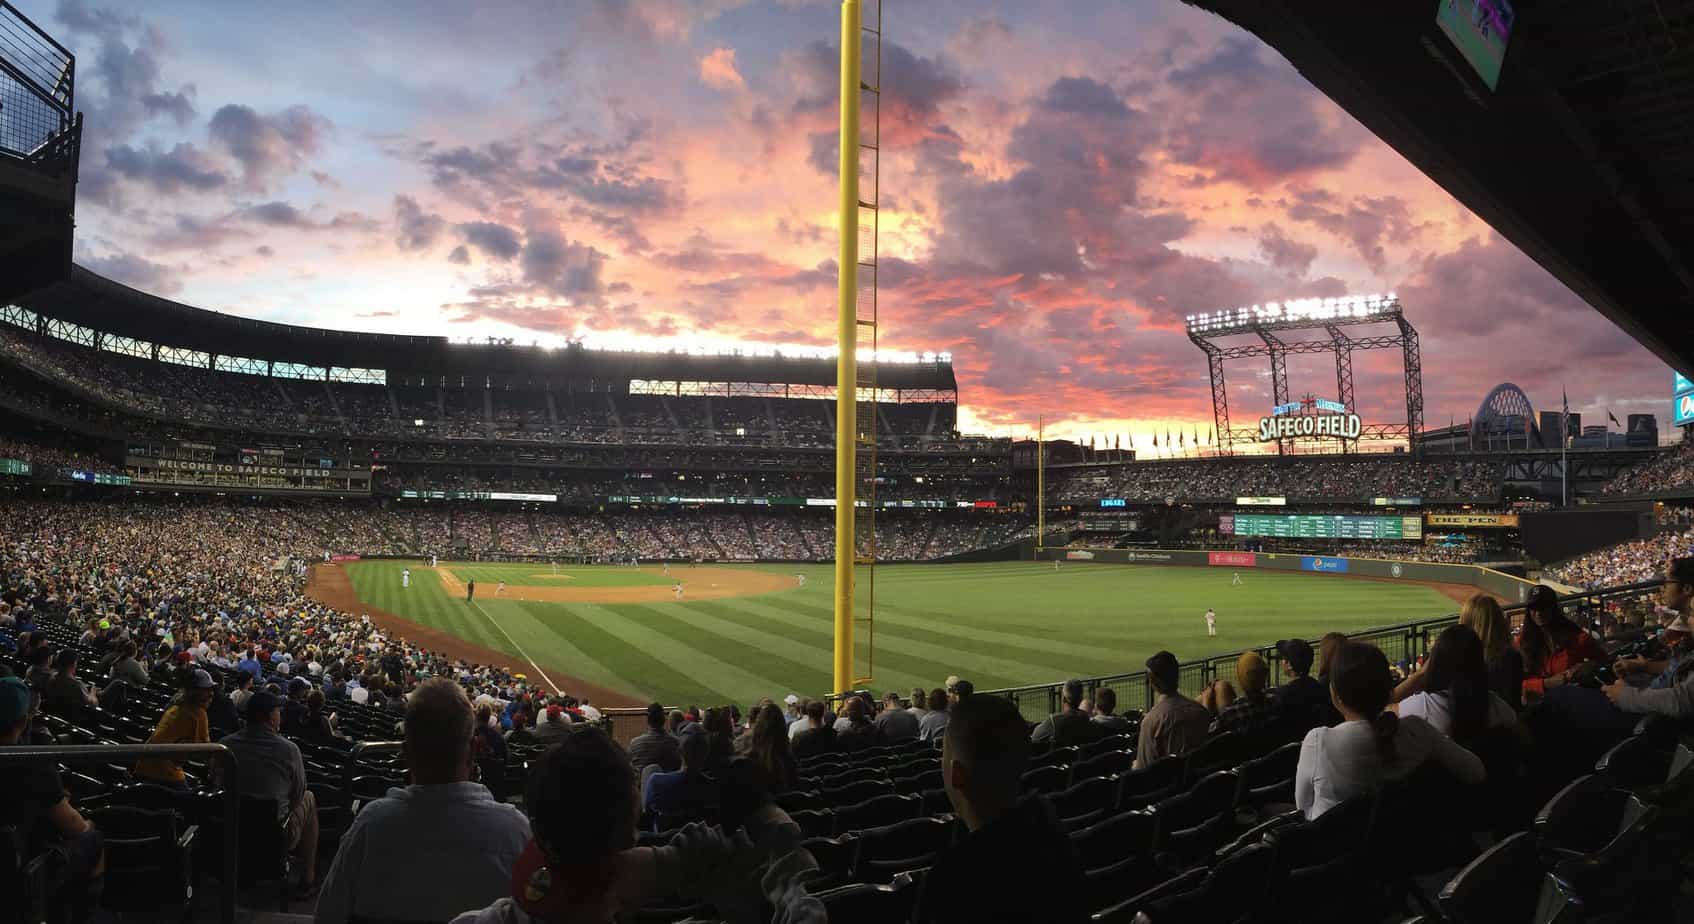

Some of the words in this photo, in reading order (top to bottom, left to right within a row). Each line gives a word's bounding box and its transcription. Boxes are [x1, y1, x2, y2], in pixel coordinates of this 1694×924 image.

[1260, 417, 1314, 440] SAFECO
[1317, 415, 1360, 438] FIELD
[158, 459, 212, 472] WELCOME
[216, 464, 233, 473] TO
[238, 466, 287, 476] SAFECO
[293, 468, 330, 477] FIELD
